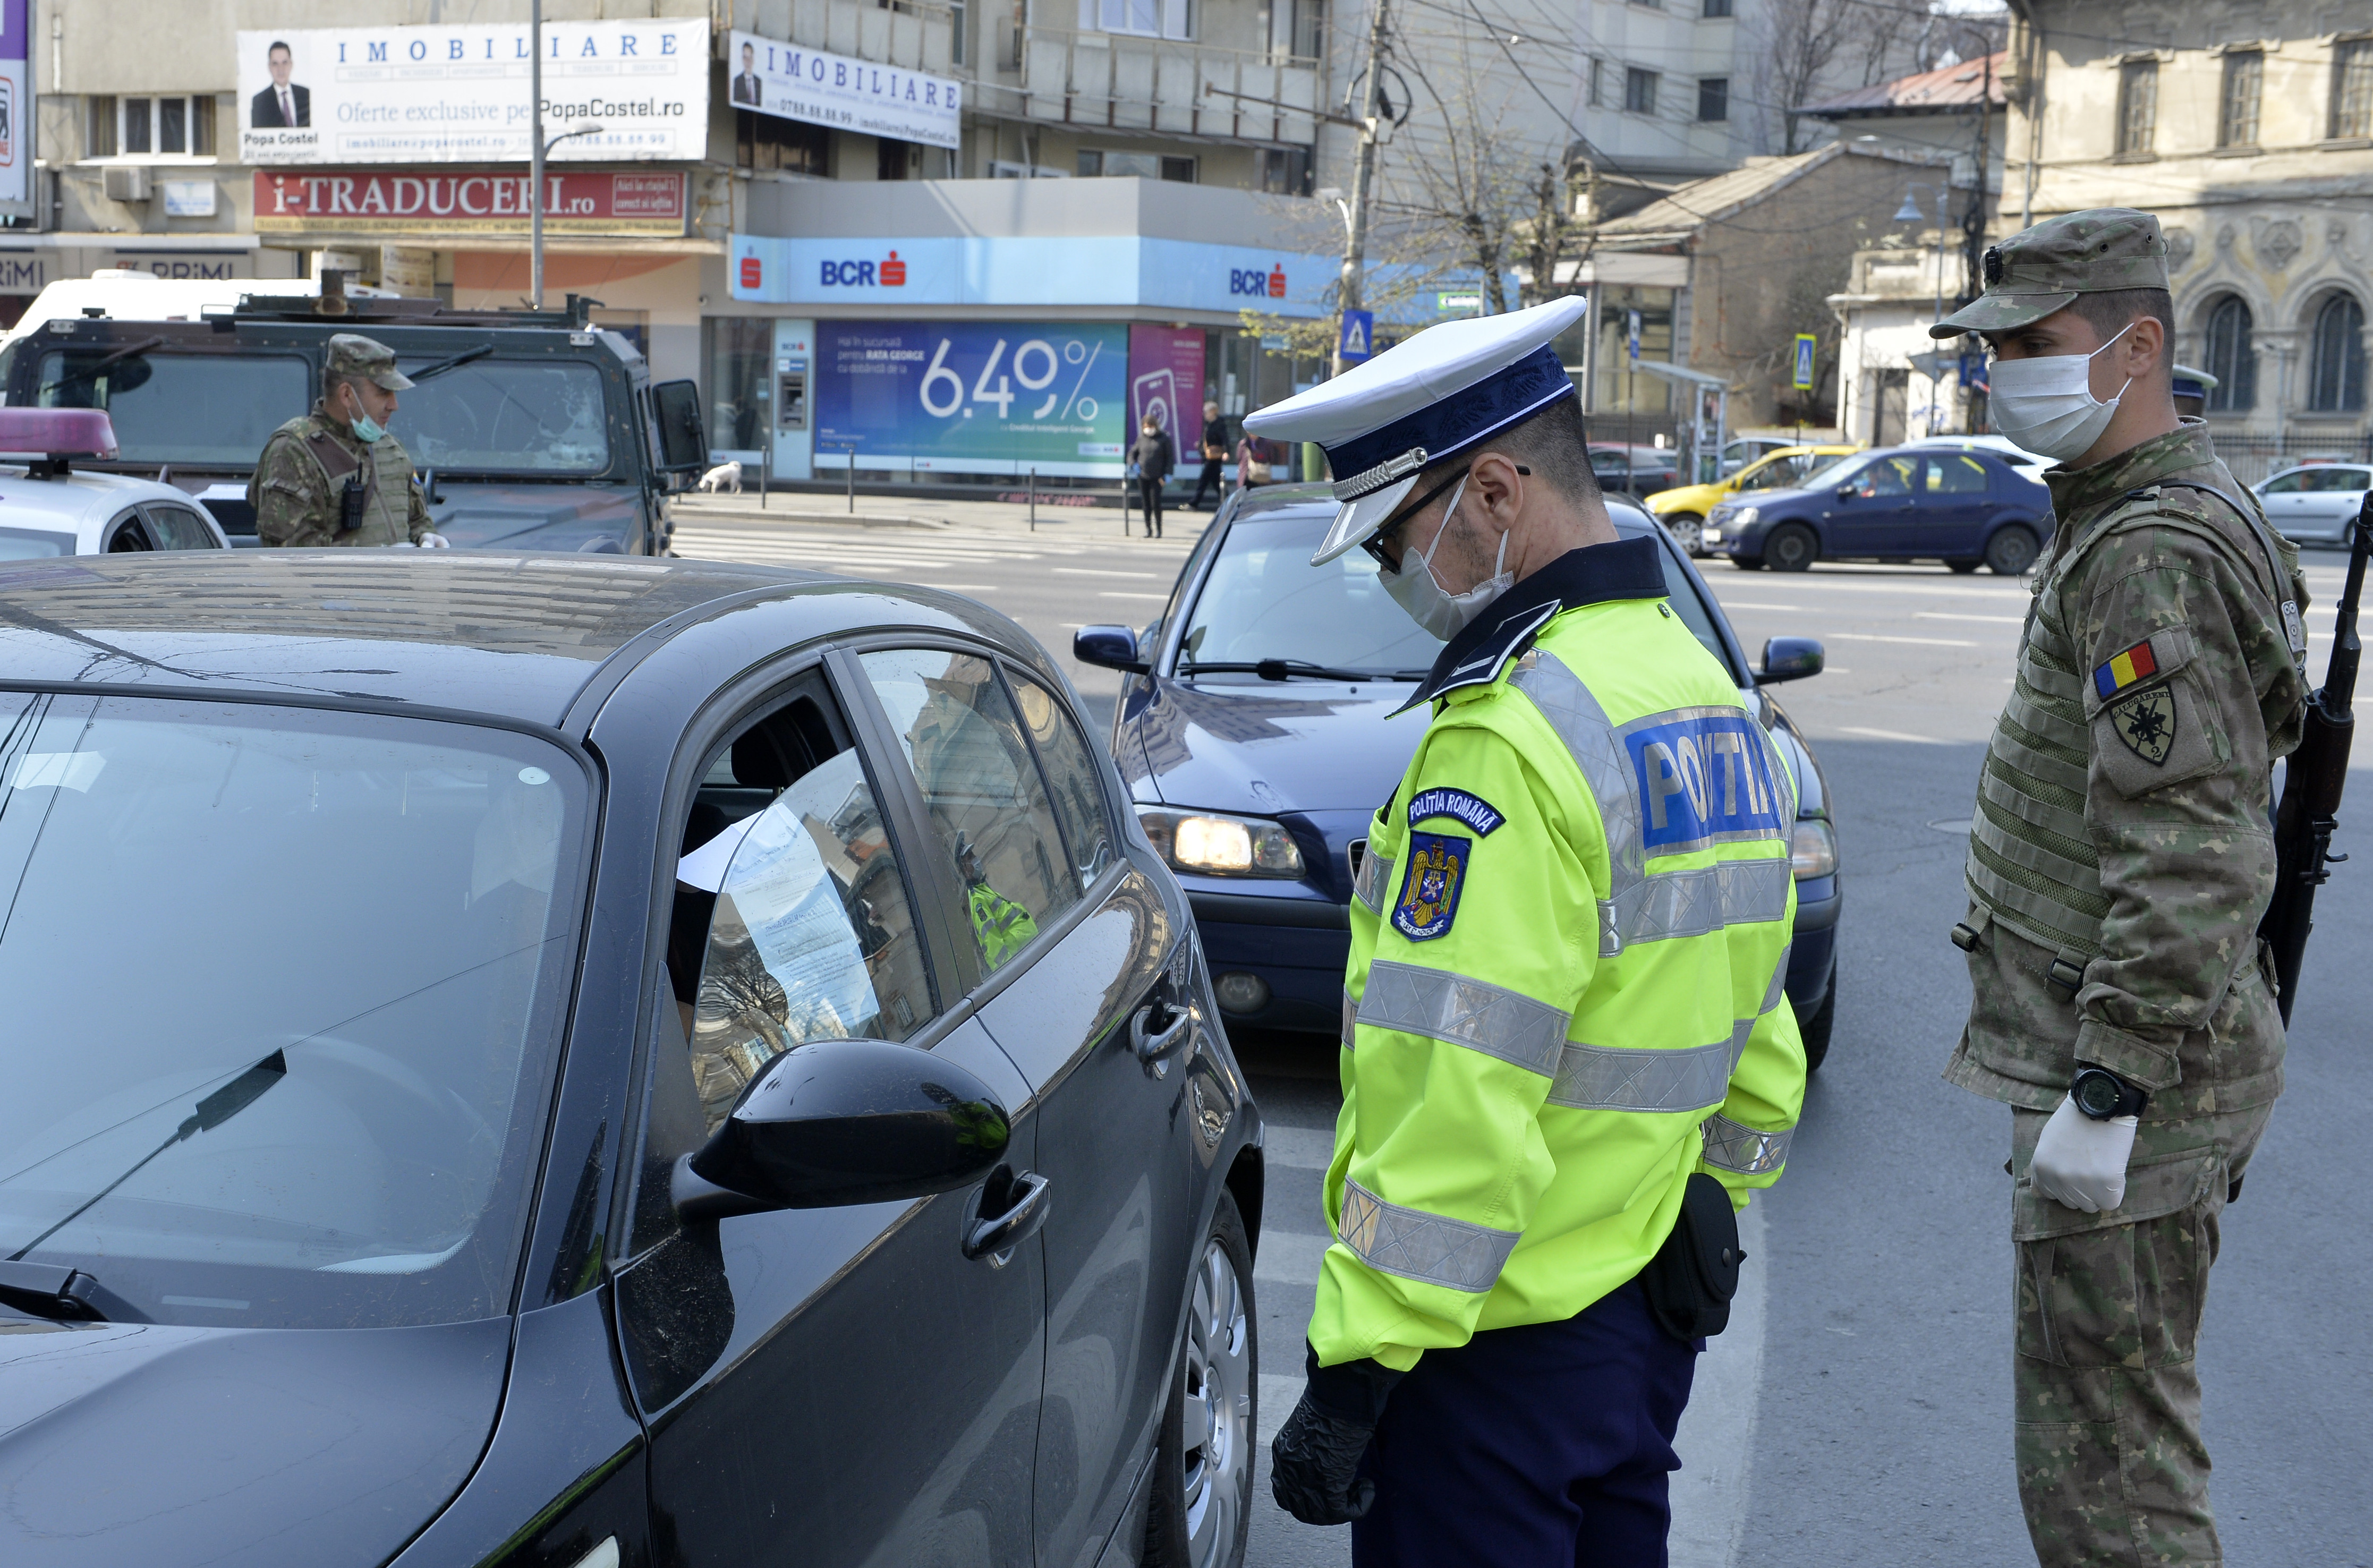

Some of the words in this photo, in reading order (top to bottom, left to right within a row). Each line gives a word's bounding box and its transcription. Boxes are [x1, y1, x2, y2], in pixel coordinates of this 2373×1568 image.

[338, 35, 677, 62] IMOBILIARE
[768, 47, 956, 109] IMOBILIARE
[337, 101, 398, 122] Oferte
[405, 99, 499, 121] exclusive
[506, 104, 531, 125] pe
[244, 133, 274, 148] Popa
[279, 132, 319, 144] Costel
[821, 260, 875, 287] BCR
[1230, 268, 1266, 296] BCR
[890, 350, 925, 361] GEORGE
[2151, 746, 2162, 759] 2
[1446, 794, 1498, 832] ROMÂNĂ
